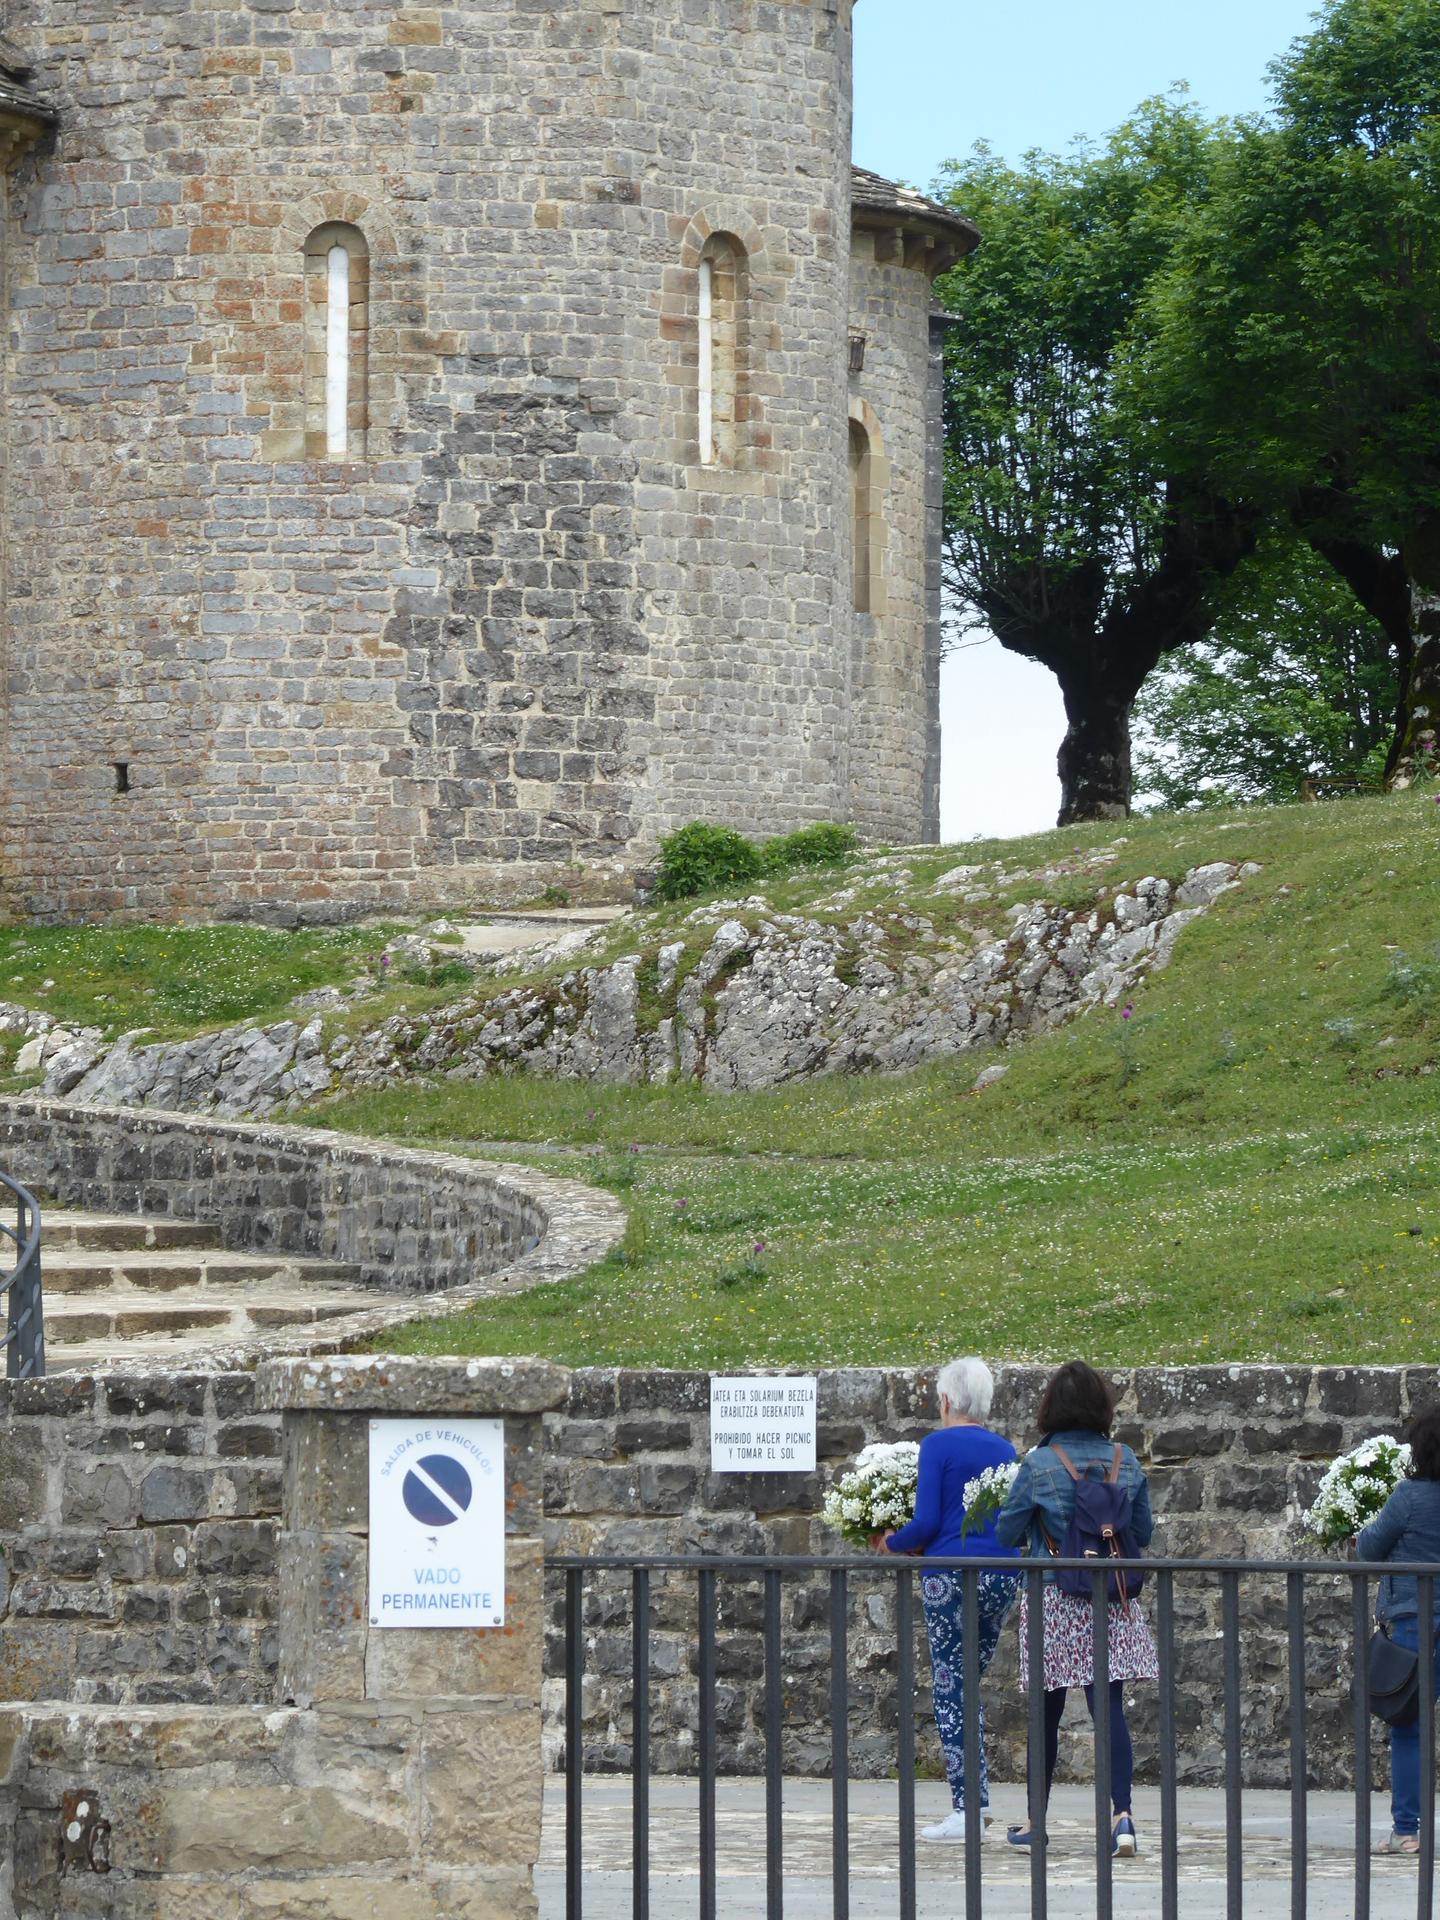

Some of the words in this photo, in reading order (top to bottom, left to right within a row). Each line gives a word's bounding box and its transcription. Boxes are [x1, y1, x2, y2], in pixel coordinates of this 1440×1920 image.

[734, 1390, 746, 1402] ETA
[750, 1390, 784, 1402] SOLARIUM
[788, 1390, 814, 1402] BEZELA
[720, 1406, 758, 1418] ERABILTZEA
[762, 1406, 804, 1418] DEBEKATUTA
[714, 1432, 752, 1444] PROHIBIDO
[756, 1432, 781, 1444] HACER
[785, 1432, 811, 1444] PICNIC
[381, 1438, 414, 1476] SALIDA
[415, 1430, 433, 1443] DE
[729, 1448, 733, 1459] Y
[737, 1448, 762, 1459] TOMAR
[767, 1448, 776, 1459] EL
[781, 1448, 795, 1459] SOL
[414, 1567, 462, 1585] VADO
[382, 1593, 492, 1609] PERMANENTE
